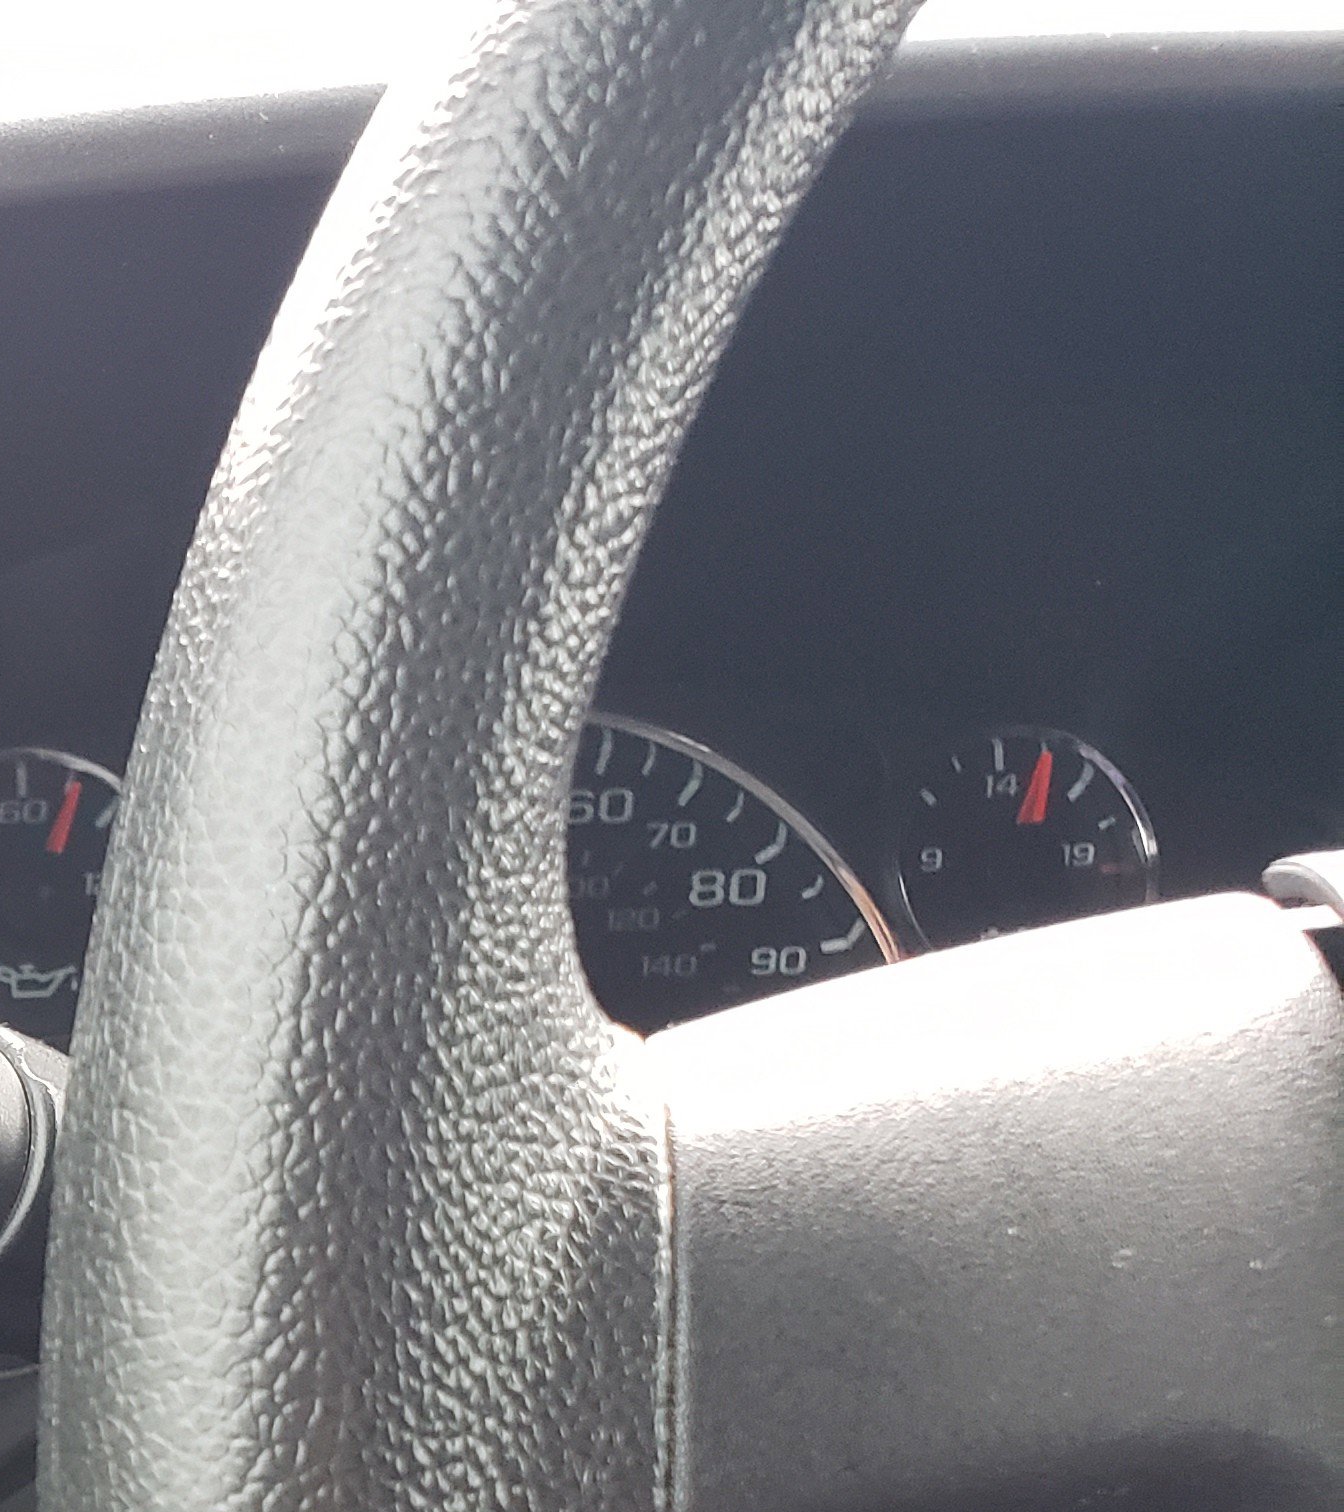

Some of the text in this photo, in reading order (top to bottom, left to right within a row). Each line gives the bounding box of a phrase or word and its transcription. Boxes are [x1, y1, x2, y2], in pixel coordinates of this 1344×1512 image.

[985, 773, 1017, 798] 14
[646, 821, 697, 848] 70
[920, 848, 943, 873] 9
[1063, 842, 1096, 867] 19
[689, 868, 767, 907] 80
[750, 945, 807, 976] 90
